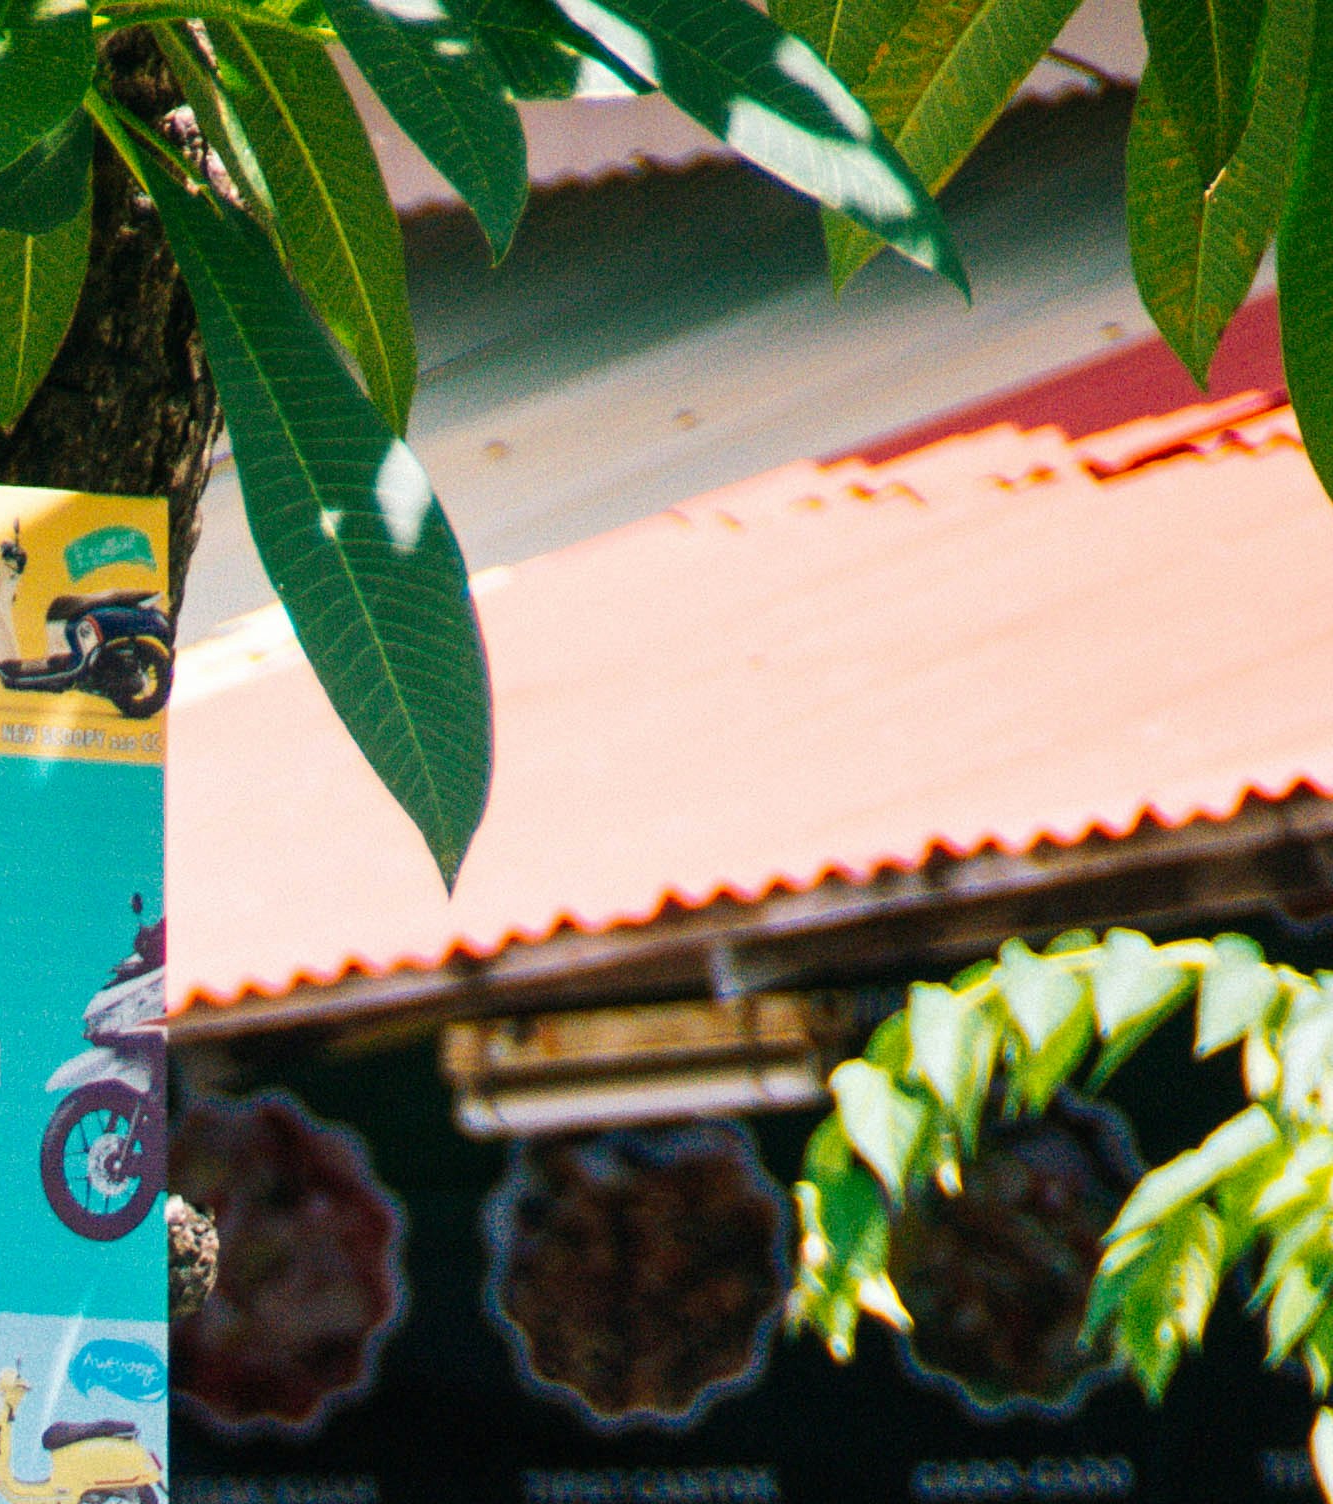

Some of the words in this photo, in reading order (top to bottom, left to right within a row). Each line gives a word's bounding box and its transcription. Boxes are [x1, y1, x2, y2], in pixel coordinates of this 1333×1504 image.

[1, 723, 37, 745] NEW
[41, 725, 107, 749] SCOOPY
[141, 732, 163, 753] CC
